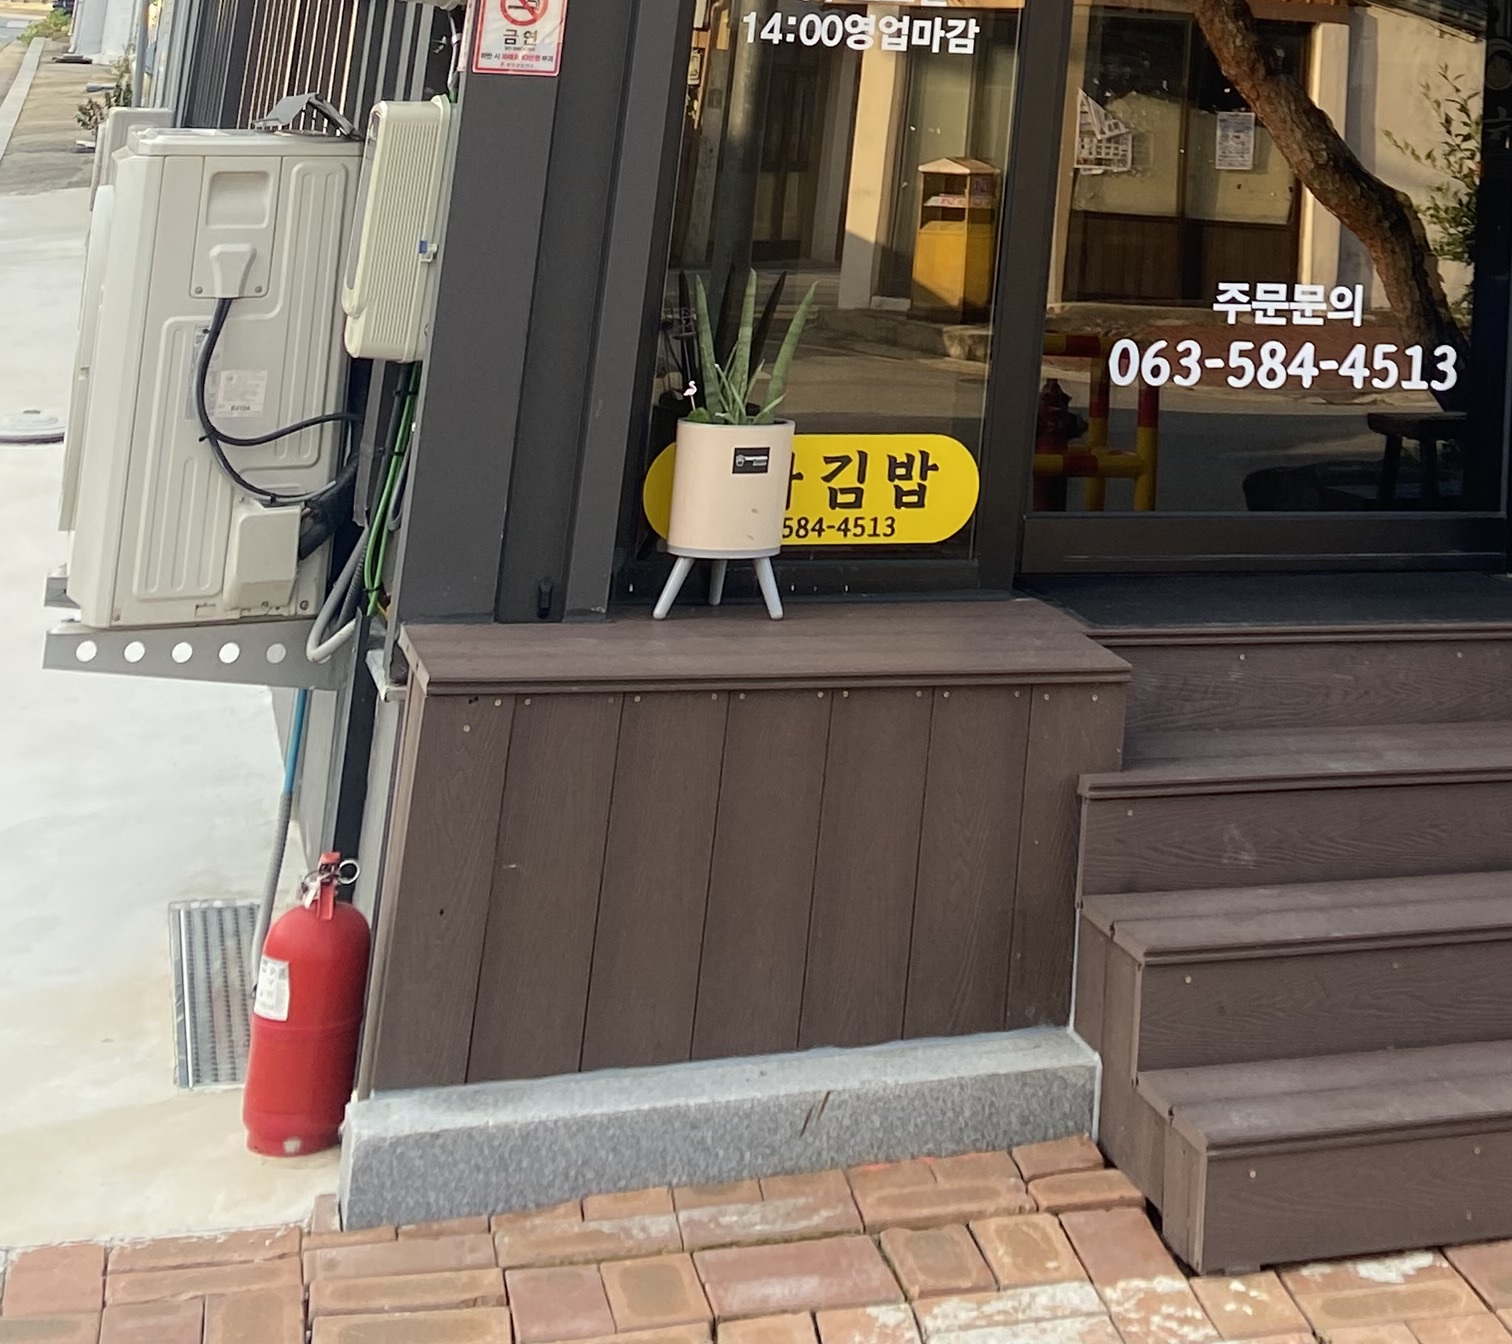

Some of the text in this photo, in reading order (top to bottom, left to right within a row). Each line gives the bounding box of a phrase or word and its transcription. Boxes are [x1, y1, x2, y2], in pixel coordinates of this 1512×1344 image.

[741, 11, 981, 55] 14:00영업마감
[1212, 281, 1364, 327] 주문문의
[1107, 338, 1458, 392] 063-584-4513
[787, 449, 940, 511] 김밥
[782, 515, 897, 539] 584-4513
